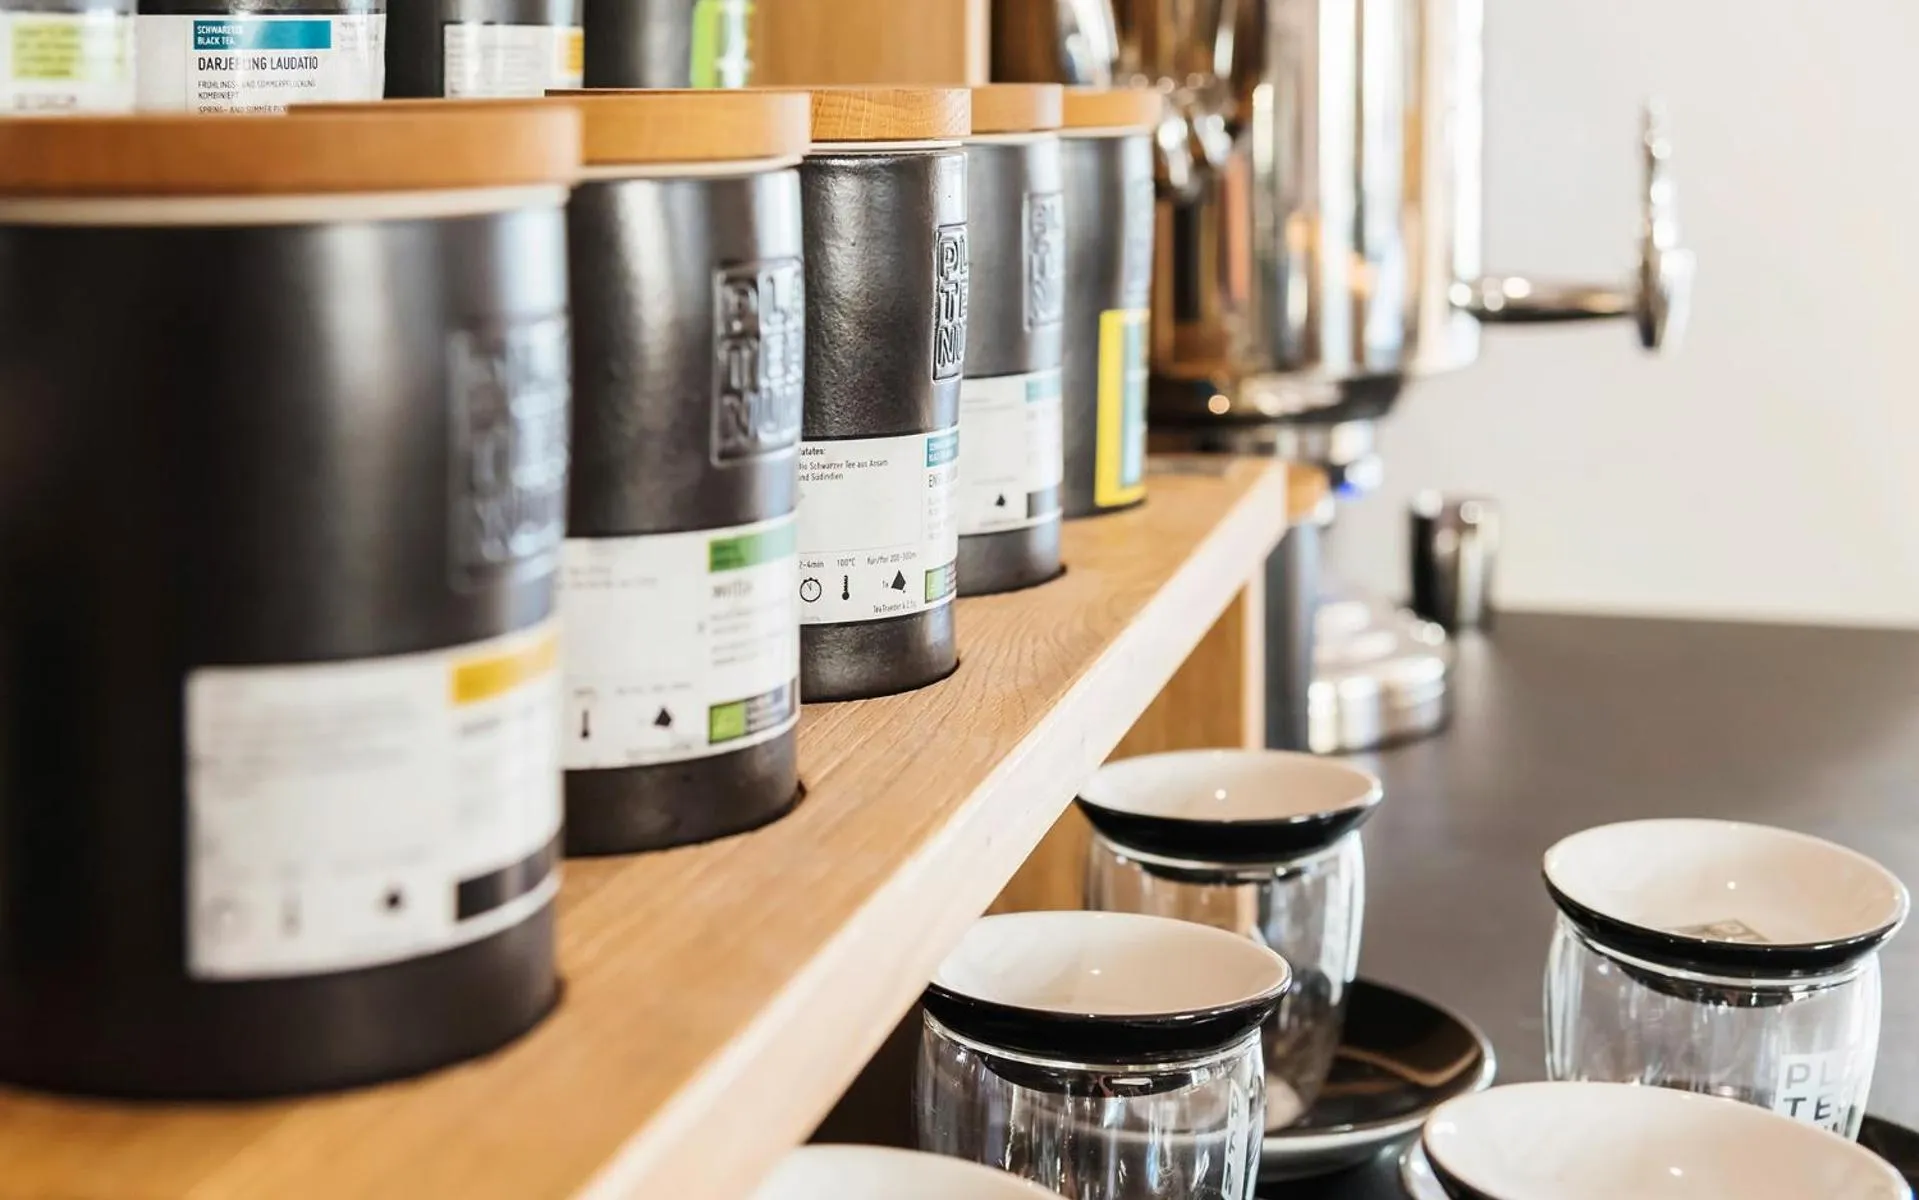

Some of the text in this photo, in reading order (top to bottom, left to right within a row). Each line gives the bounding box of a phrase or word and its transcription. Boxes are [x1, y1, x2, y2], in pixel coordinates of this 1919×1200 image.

[197, 36, 236, 45] BLACK TEA
[270, 56, 319, 71] LAUDATIO
[809, 461, 844, 471] Schwarzer
[845, 460, 856, 469] Tee
[857, 460, 868, 469] aus
[837, 557, 856, 568] 100°C
